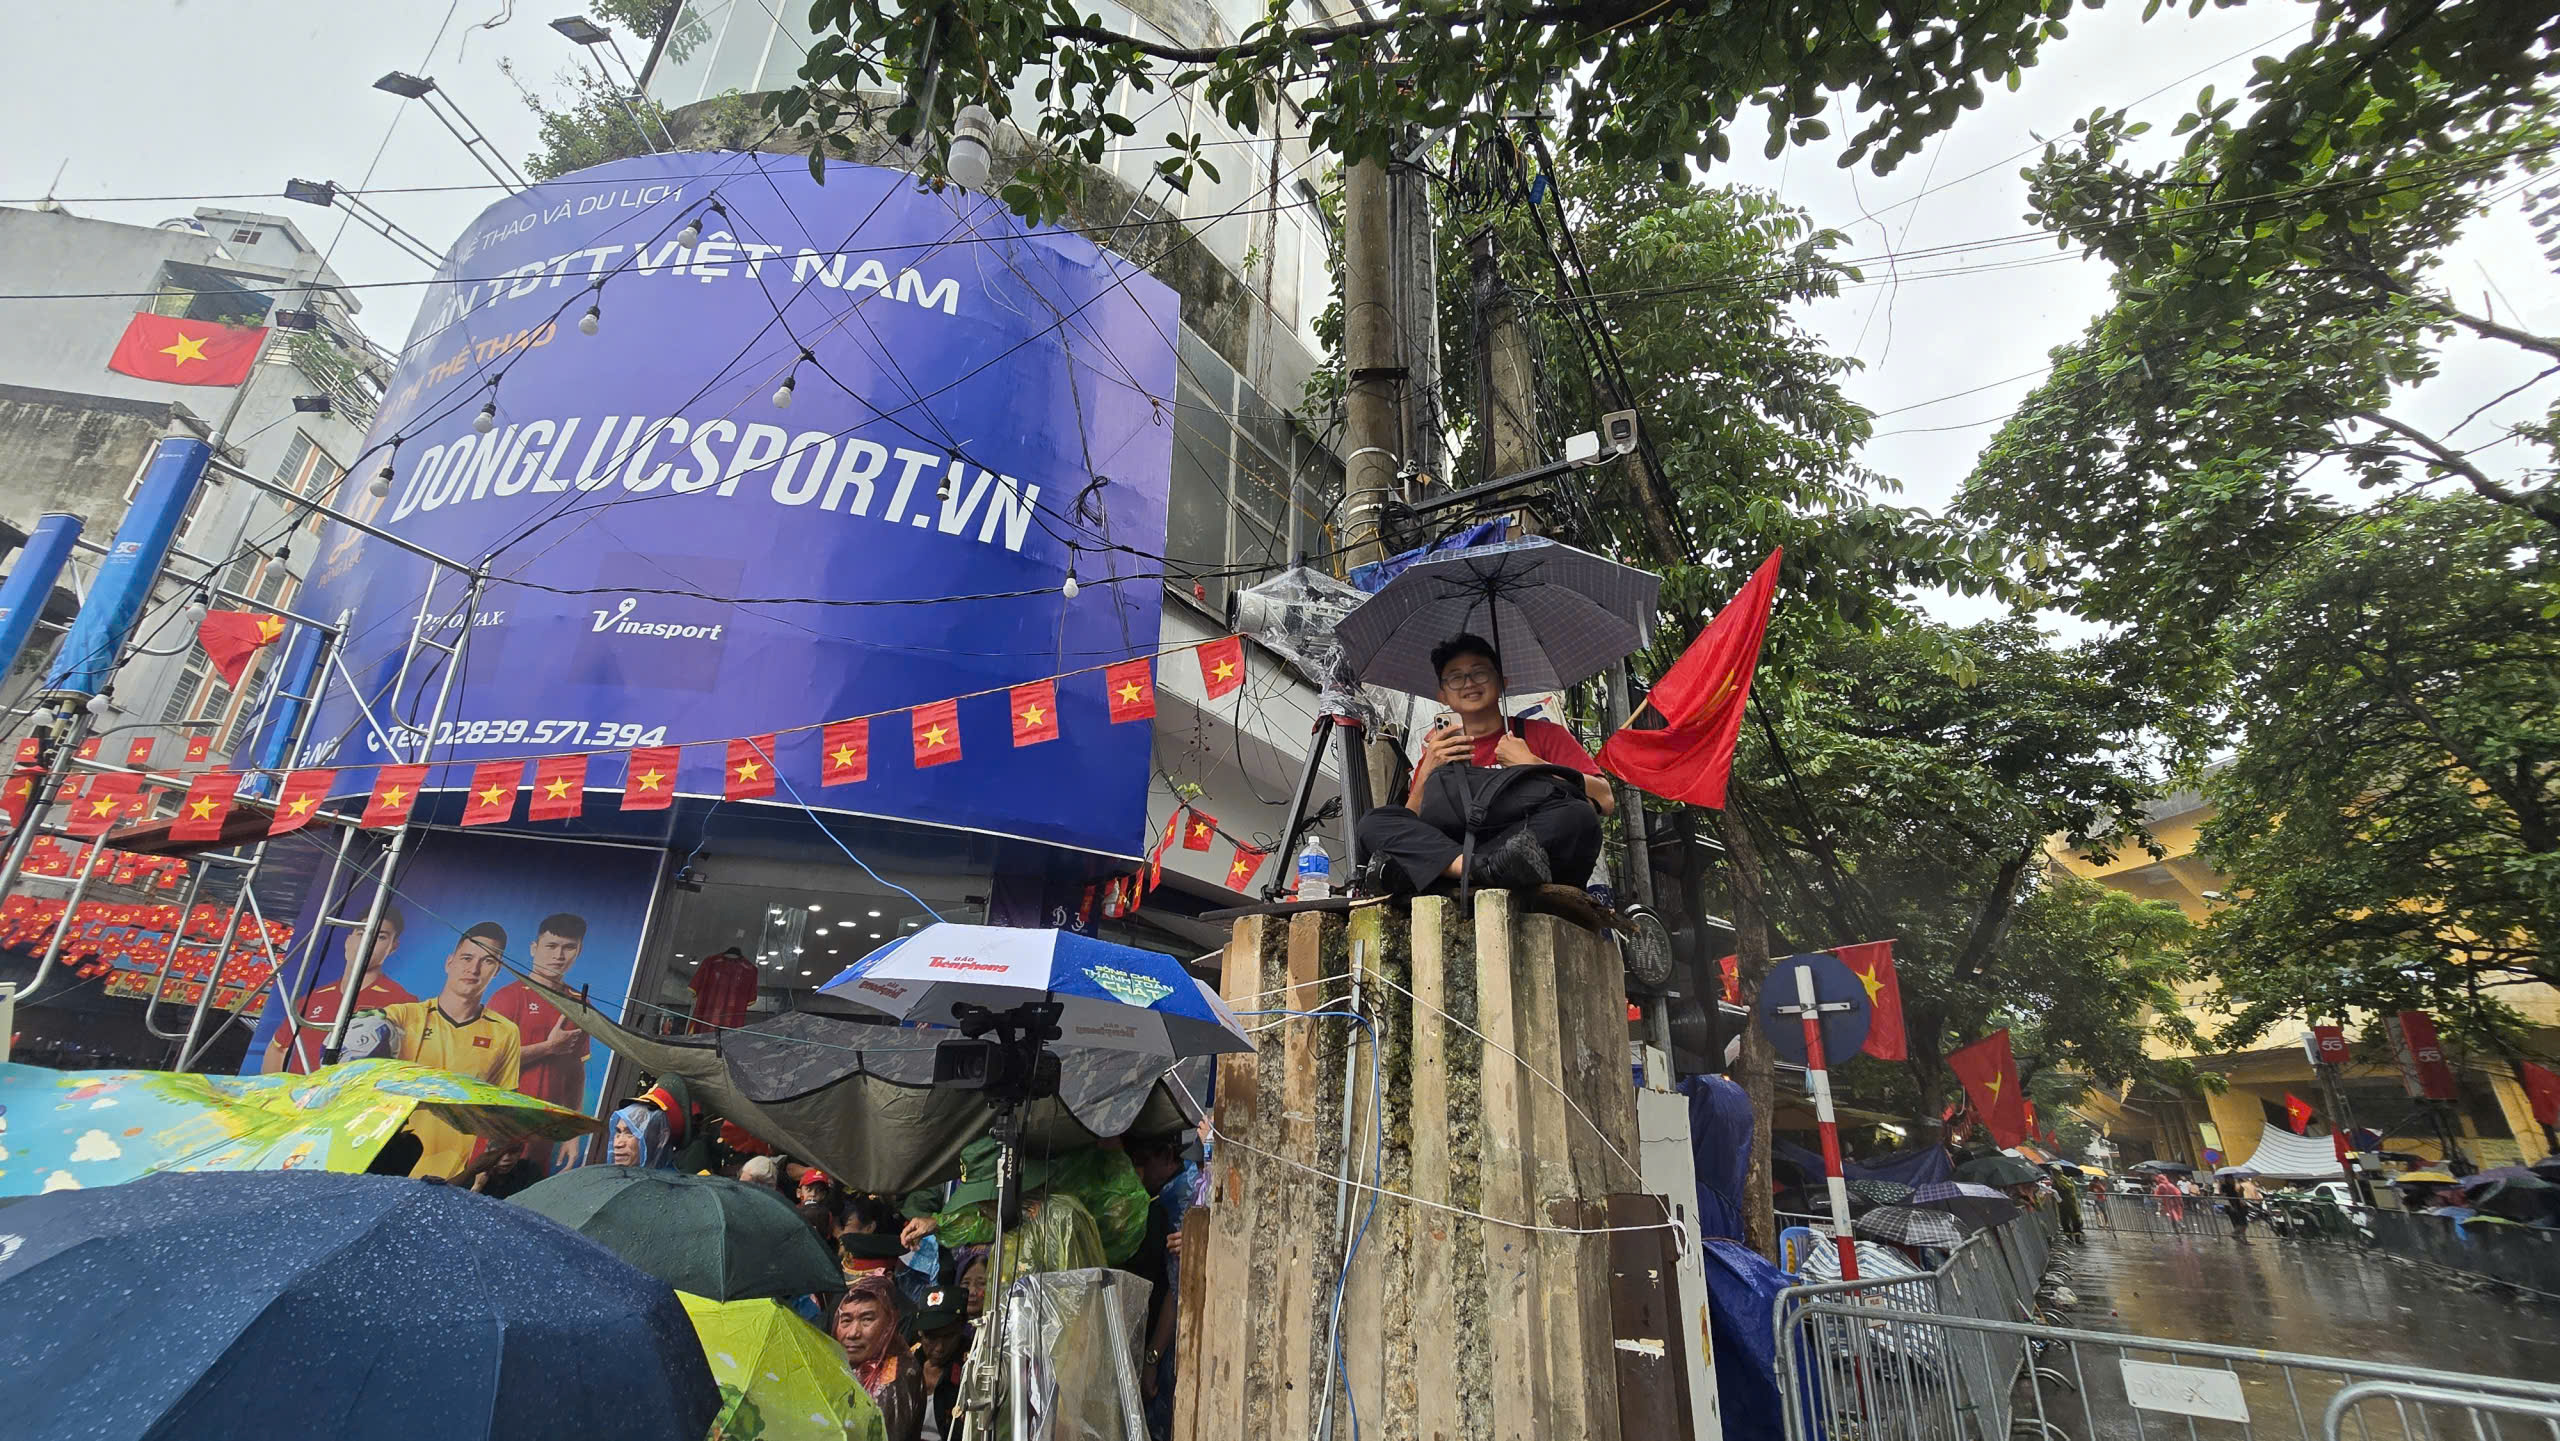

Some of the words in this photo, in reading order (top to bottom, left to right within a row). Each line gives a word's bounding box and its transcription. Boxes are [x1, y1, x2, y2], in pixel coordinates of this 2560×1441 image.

[482, 214, 537, 250] THAO
[541, 200, 571, 226] VÀ
[577, 190, 617, 216] DU
[619, 184, 685, 212] LỊCH
[487, 243, 625, 309] TDTT
[634, 231, 783, 283] VIỆT
[792, 248, 960, 316] NAM
[474, 320, 558, 364] THAO
[389, 415, 1042, 553] DONGLUCSPORT.VN
[592, 597, 723, 641] Vinasport
[434, 720, 668, 748] 02839.571.394
[2321, 1040, 2342, 1051] 5G
[2418, 1050, 2441, 1063] 5G
